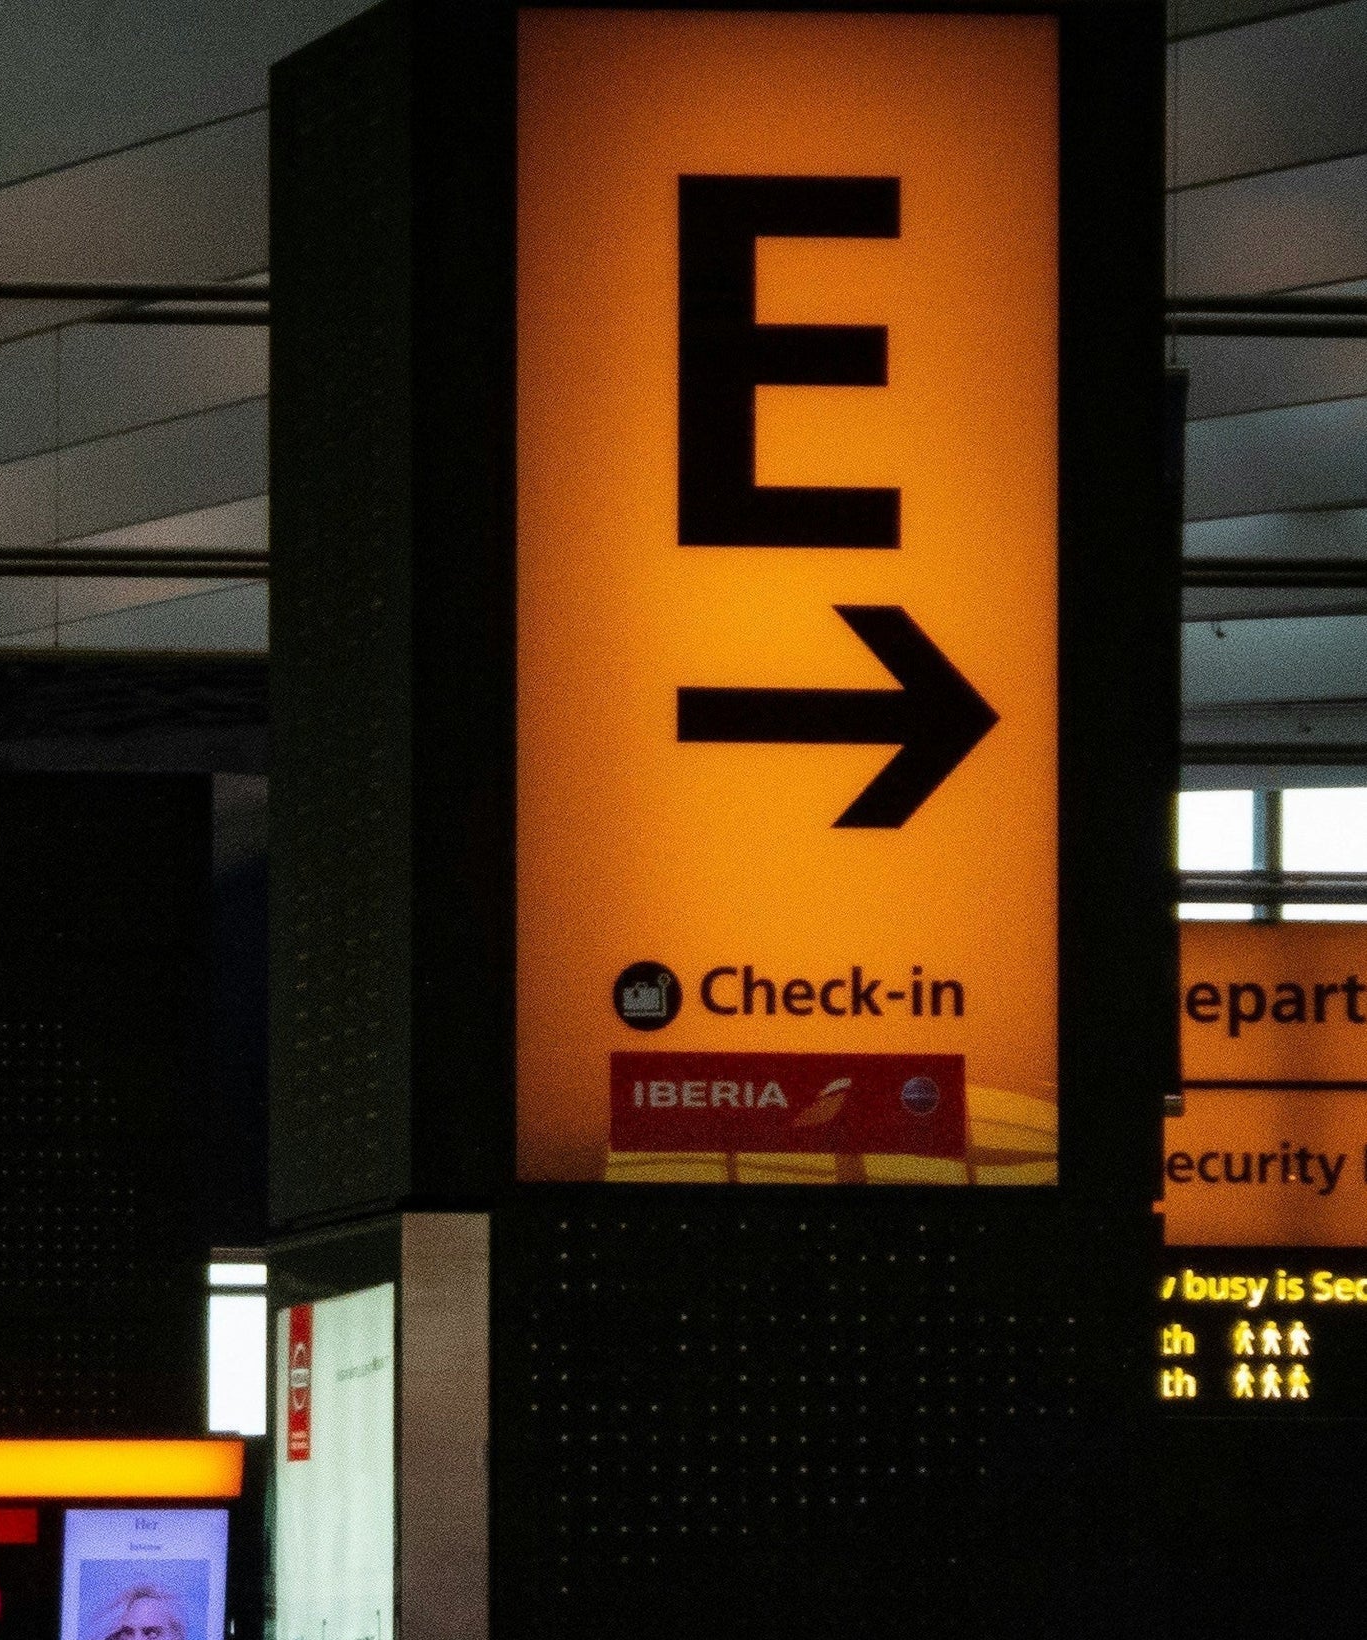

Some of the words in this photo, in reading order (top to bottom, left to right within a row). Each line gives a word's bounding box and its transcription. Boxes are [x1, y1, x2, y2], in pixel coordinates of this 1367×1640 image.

[678, 175, 901, 549] E
[700, 966, 965, 1017] Check-in
[1185, 975, 1367, 1037] epart
[633, 1080, 789, 1109] IBERIA
[1166, 1142, 1347, 1196] ecurity
[1183, 1269, 1268, 1307] busy
[1277, 1270, 1305, 1301] is
